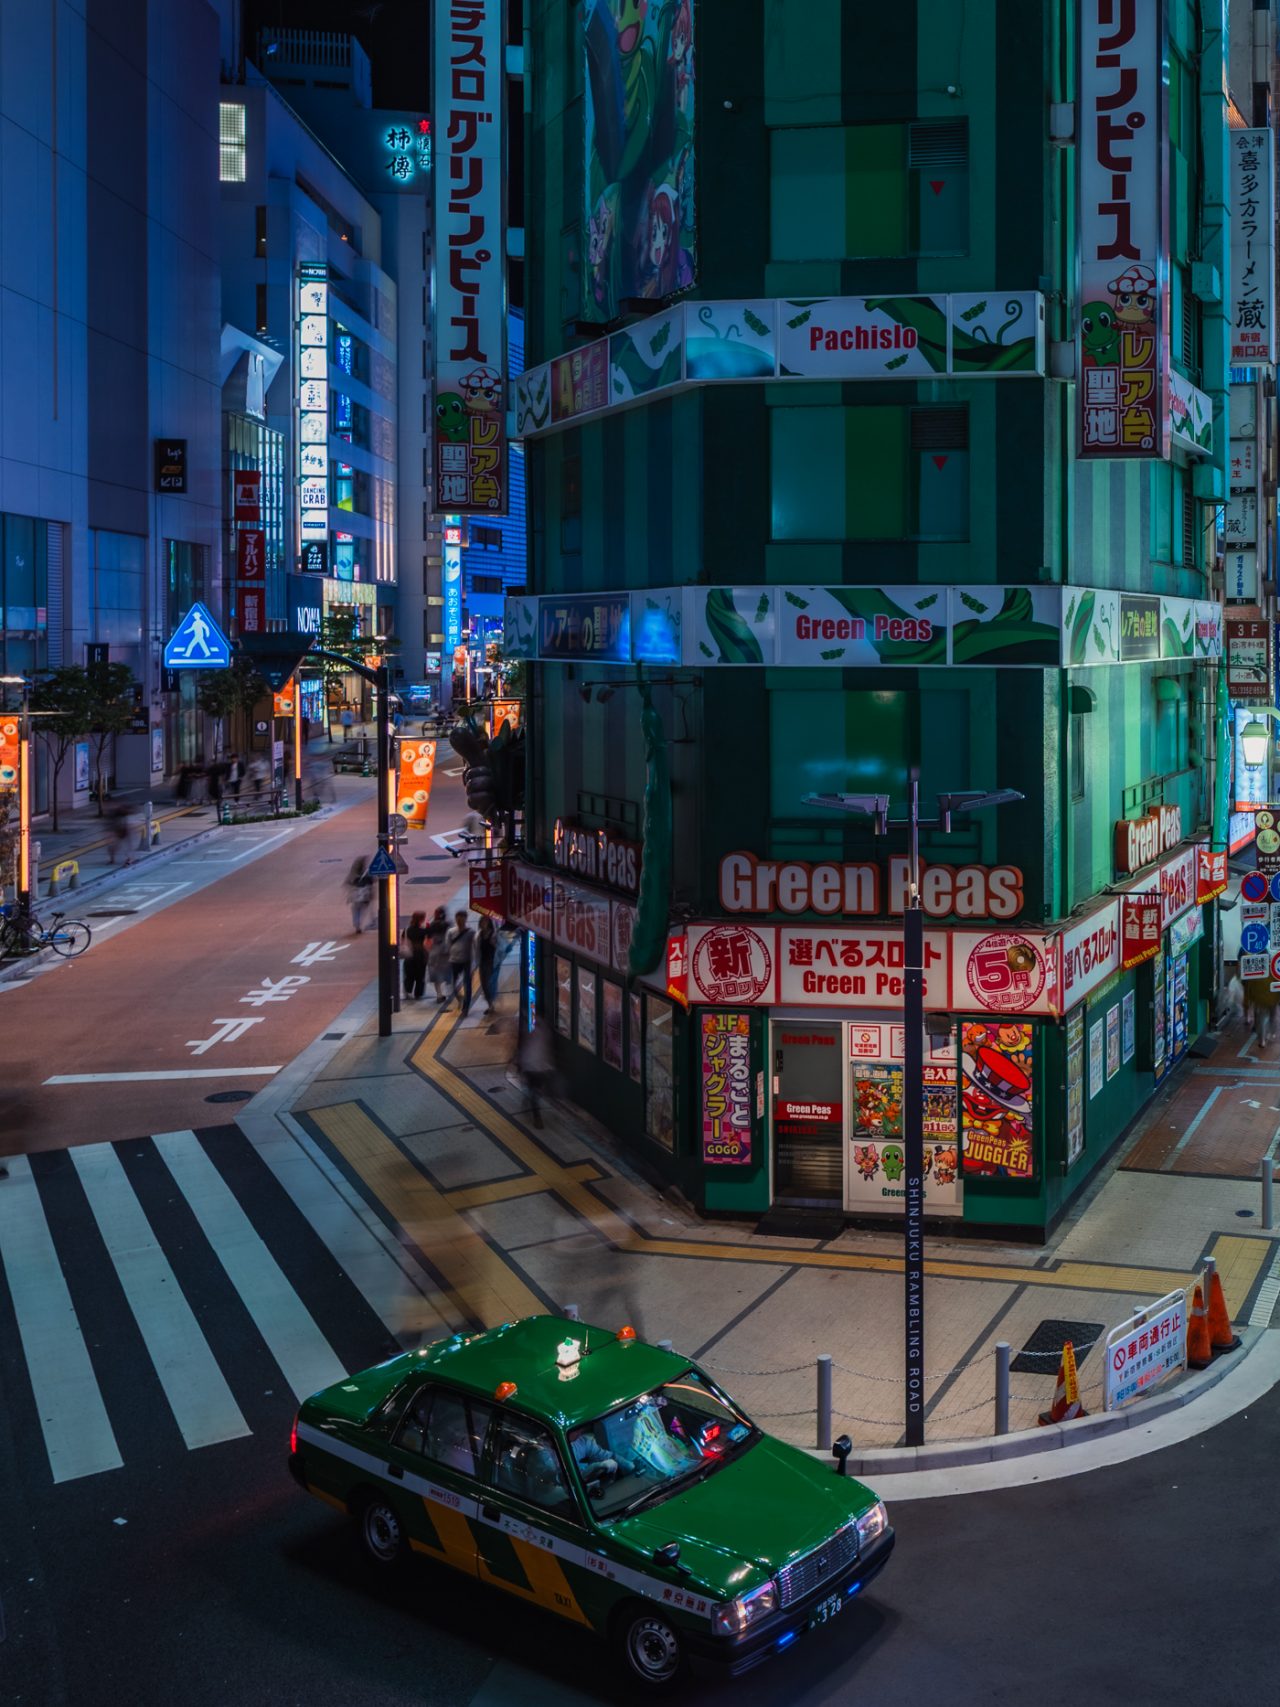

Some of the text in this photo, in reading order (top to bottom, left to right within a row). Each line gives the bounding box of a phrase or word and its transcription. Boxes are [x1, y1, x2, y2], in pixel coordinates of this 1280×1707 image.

[1236, 136, 1265, 150] 会津
[446, 111, 492, 364] グリンピース
[809, 324, 919, 352] Pachislo
[1231, 345, 1268, 358] 南口店
[1240, 332, 1261, 343] 新宿
[1121, 330, 1155, 450] レア台の
[1084, 367, 1119, 447] 聖地
[438, 442, 470, 505] 聖地
[469, 416, 499, 509] レア台の
[244, 533, 259, 577] マルハン
[795, 614, 933, 642] Green Peas
[553, 817, 637, 890] Green Peas
[1127, 805, 1182, 874] Green Peas
[719, 851, 1024, 920] Green Peas
[1160, 863, 1188, 923] Peas
[1125, 908, 1158, 941] 新台 入替
[1247, 931, 1258, 950] P
[707, 931, 752, 981] 新
[788, 937, 942, 968] 選べるスロト
[1063, 920, 1118, 990] 選べるスロット
[707, 979, 766, 1001] スロット
[803, 971, 928, 998] Green Pes
[987, 989, 1035, 1005] スロット
[715, 1013, 738, 1031] 1F
[705, 1034, 729, 1139] ジャグラー
[727, 1034, 753, 1128] まるごと
[786, 1103, 832, 1116] Green Peas
[706, 1143, 740, 1156] GOGO
[963, 1140, 1029, 1172] JUGGLER
[967, 1131, 1007, 1148] GreenPeas
[908, 1177, 921, 1414] SHINJUKU RAMBLING ROAD
[1127, 1313, 1182, 1360] 車両通行止
[553, 1591, 572, 1608] TAXI
